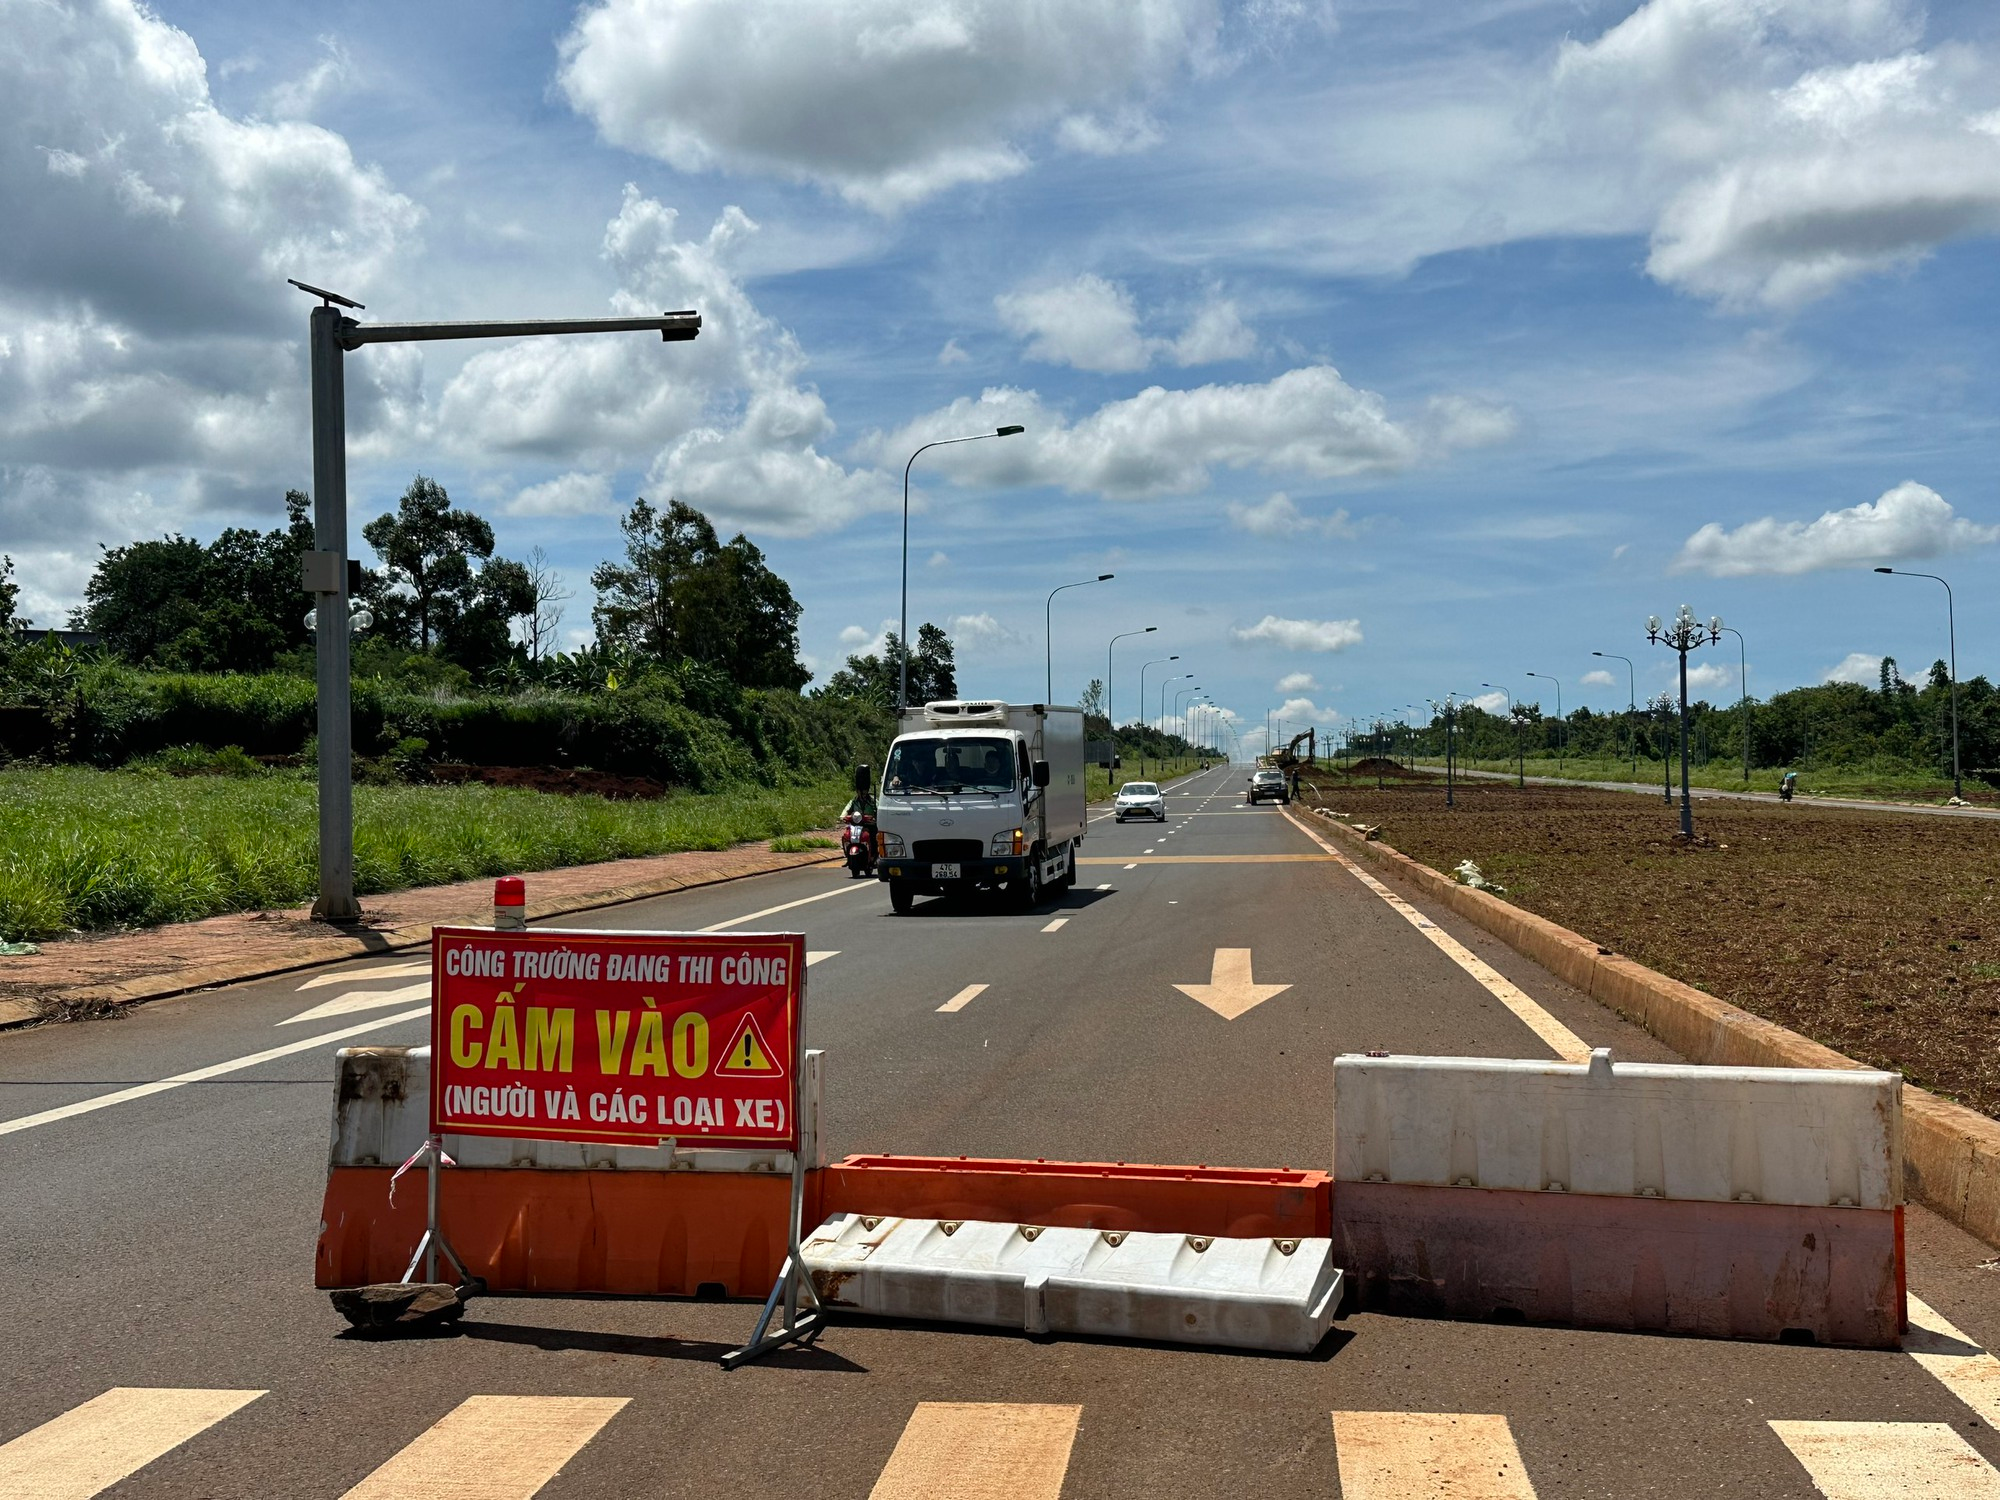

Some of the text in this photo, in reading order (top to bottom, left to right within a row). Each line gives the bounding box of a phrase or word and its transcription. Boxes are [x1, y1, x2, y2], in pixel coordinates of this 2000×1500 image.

[446, 944, 786, 986] CÔNG TRƯỜNG ĐANG THI CÔNG
[450, 983, 710, 1079] CẤM VÀO
[444, 1081, 786, 1133] (NGƯỜI VÀ CÁC LOẠI XE)
